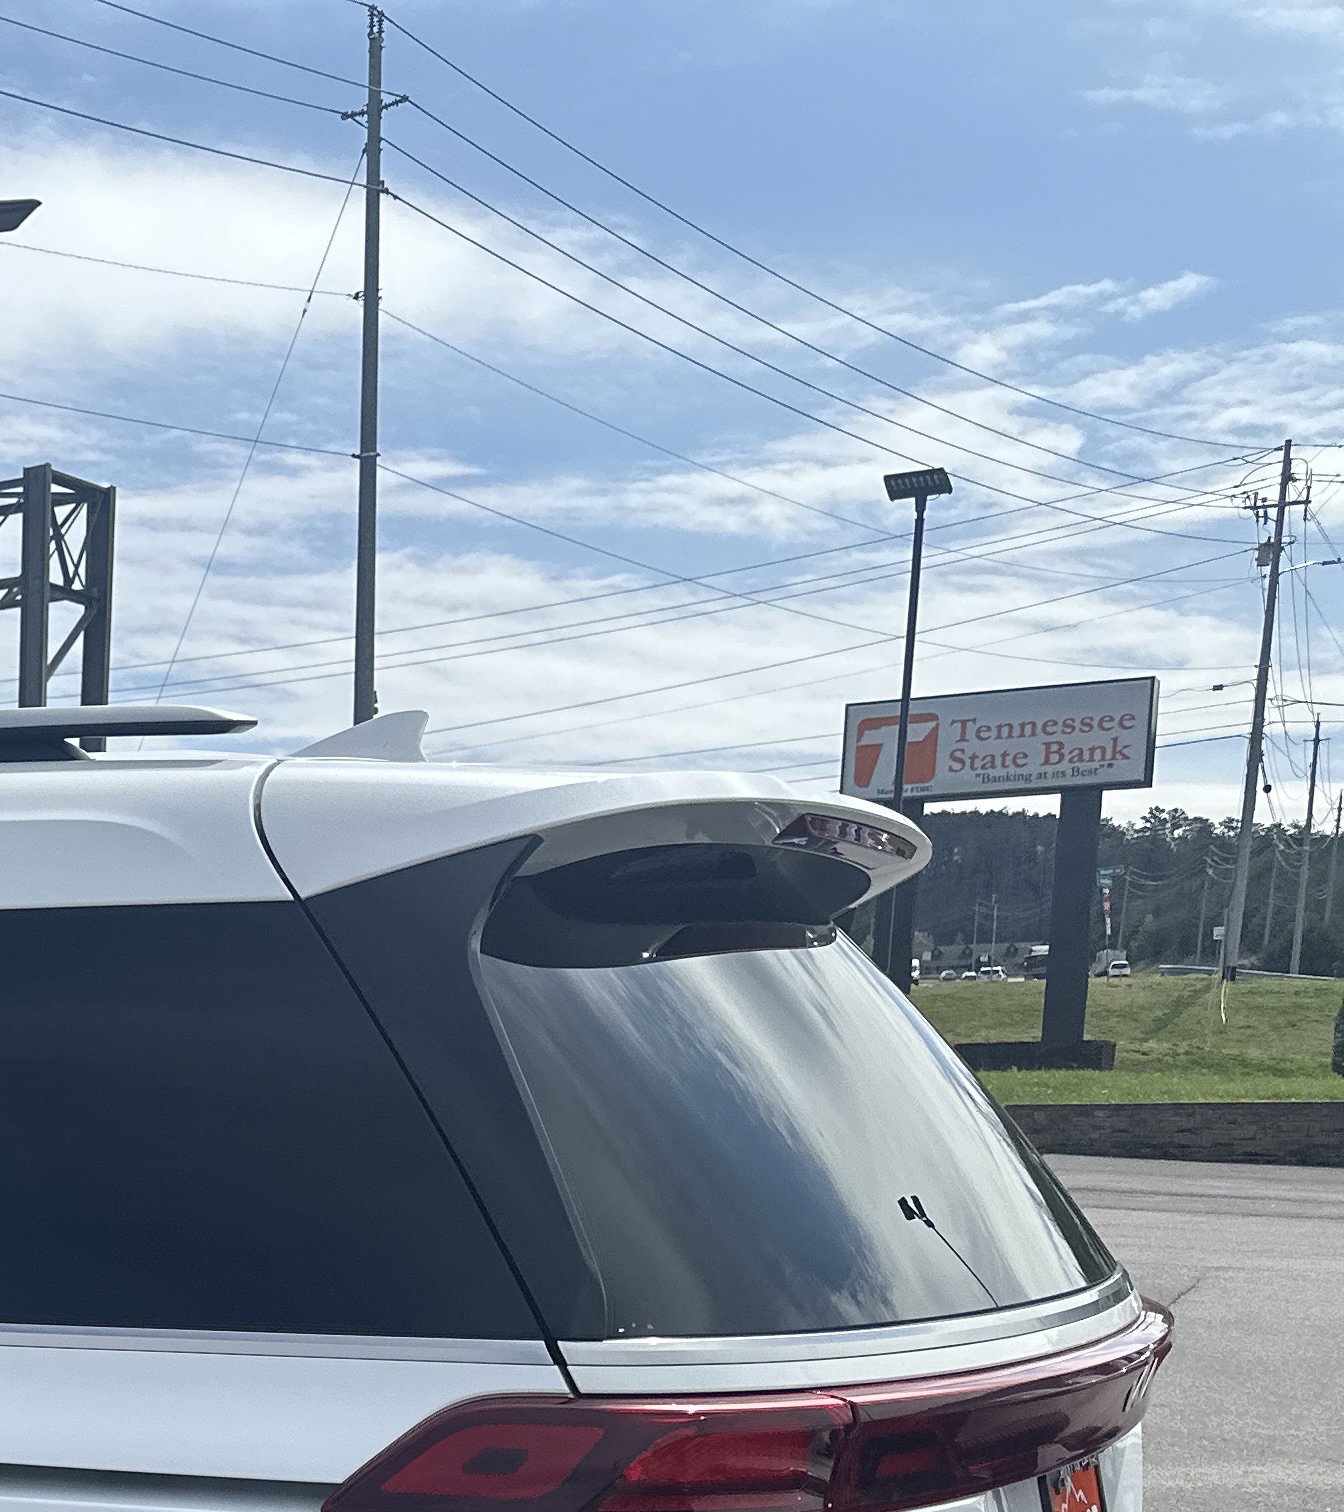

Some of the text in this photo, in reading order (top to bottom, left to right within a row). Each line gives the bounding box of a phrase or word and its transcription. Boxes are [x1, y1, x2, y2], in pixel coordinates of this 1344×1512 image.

[949, 712, 1137, 743] Tennessee
[948, 736, 1132, 773] State Bank
[1036, 771, 1048, 781] at
